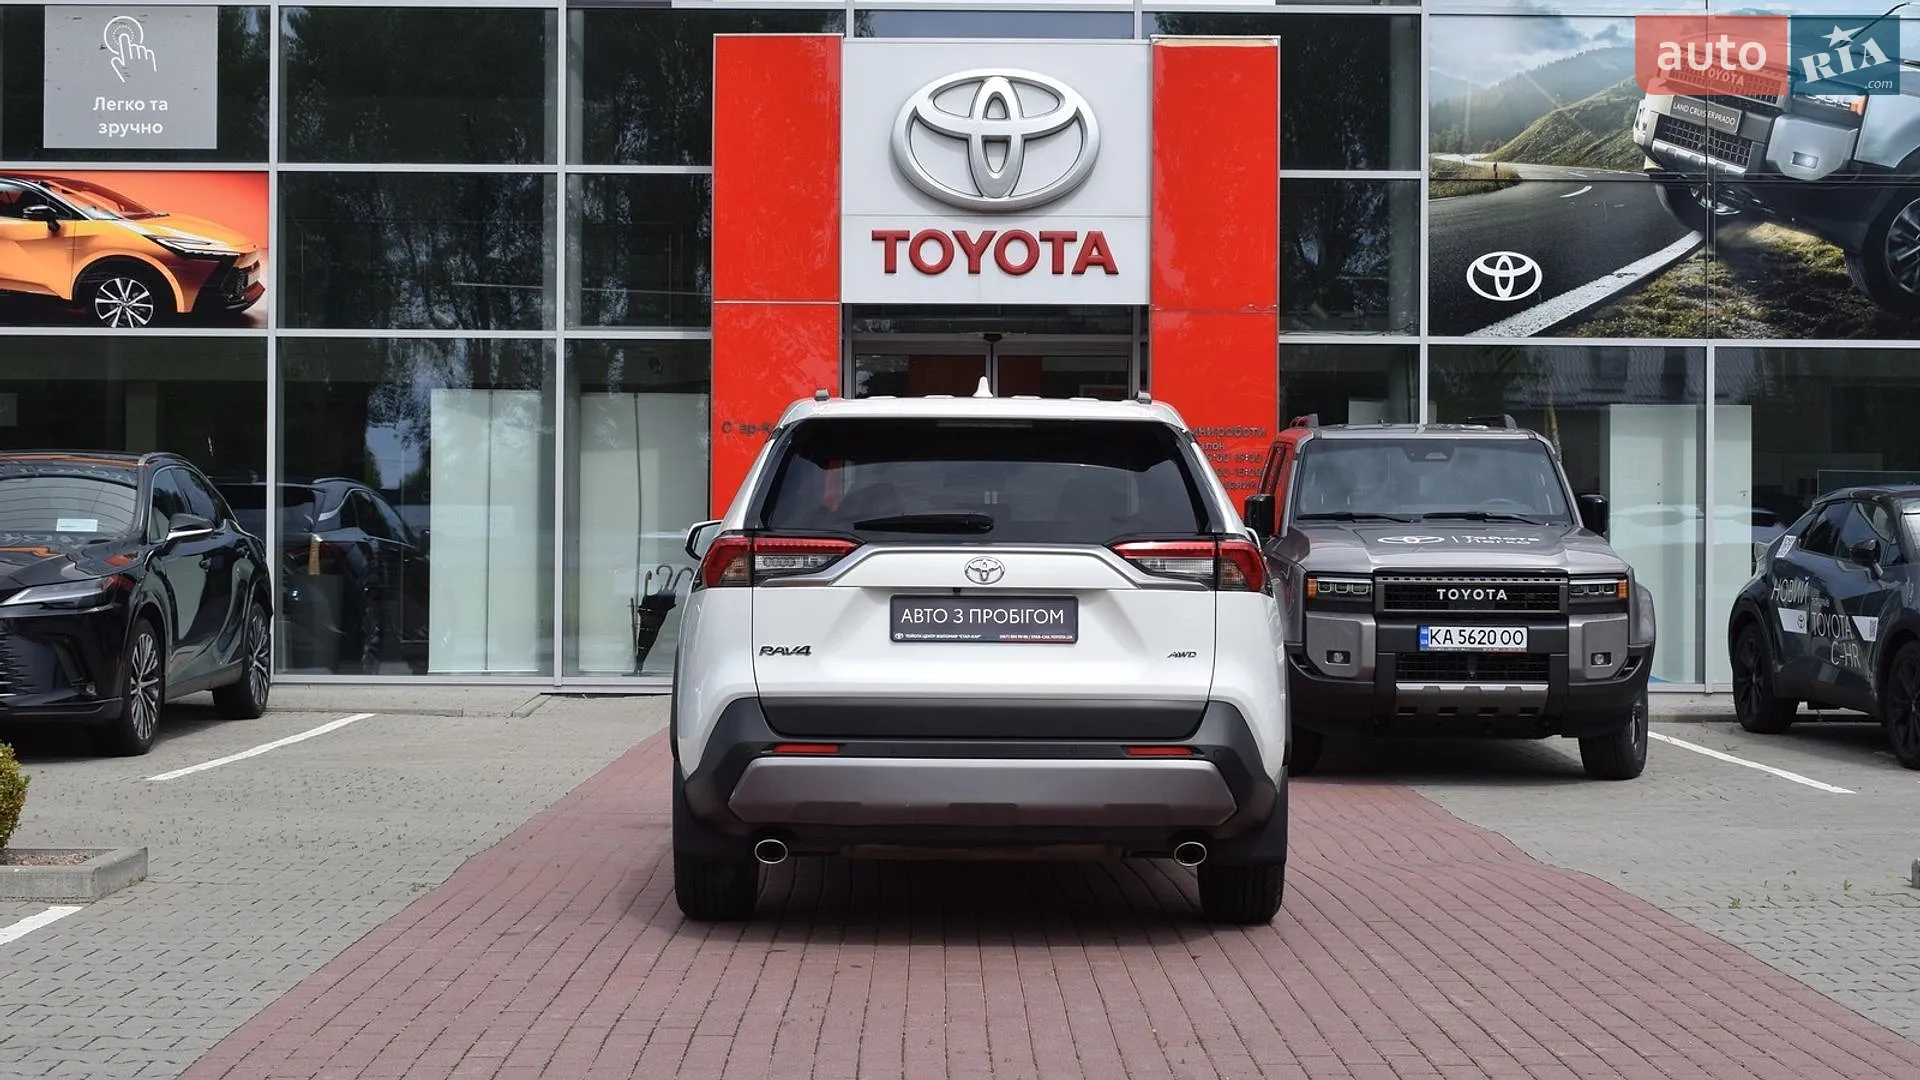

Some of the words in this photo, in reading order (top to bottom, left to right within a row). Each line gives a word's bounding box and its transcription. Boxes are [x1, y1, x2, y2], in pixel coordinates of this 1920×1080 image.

[92, 96, 145, 111] Легко
[149, 99, 168, 111] та
[1672, 102, 1690, 113] LAND
[98, 122, 163, 138] зручно
[871, 229, 1119, 275] TOYOTA
[1436, 588, 1508, 601] TOYOTA
[900, 608, 948, 624] АВТО
[952, 608, 965, 624] З
[968, 608, 1064, 624] ПРОБІГОМ
[1811, 612, 1855, 640] TOYOTA
[1430, 629, 1454, 645] KA
[1458, 629, 1497, 645] 5620
[758, 645, 812, 657] RAV4
[1166, 650, 1197, 659] AWD
[1831, 641, 1861, 669] C-HR
